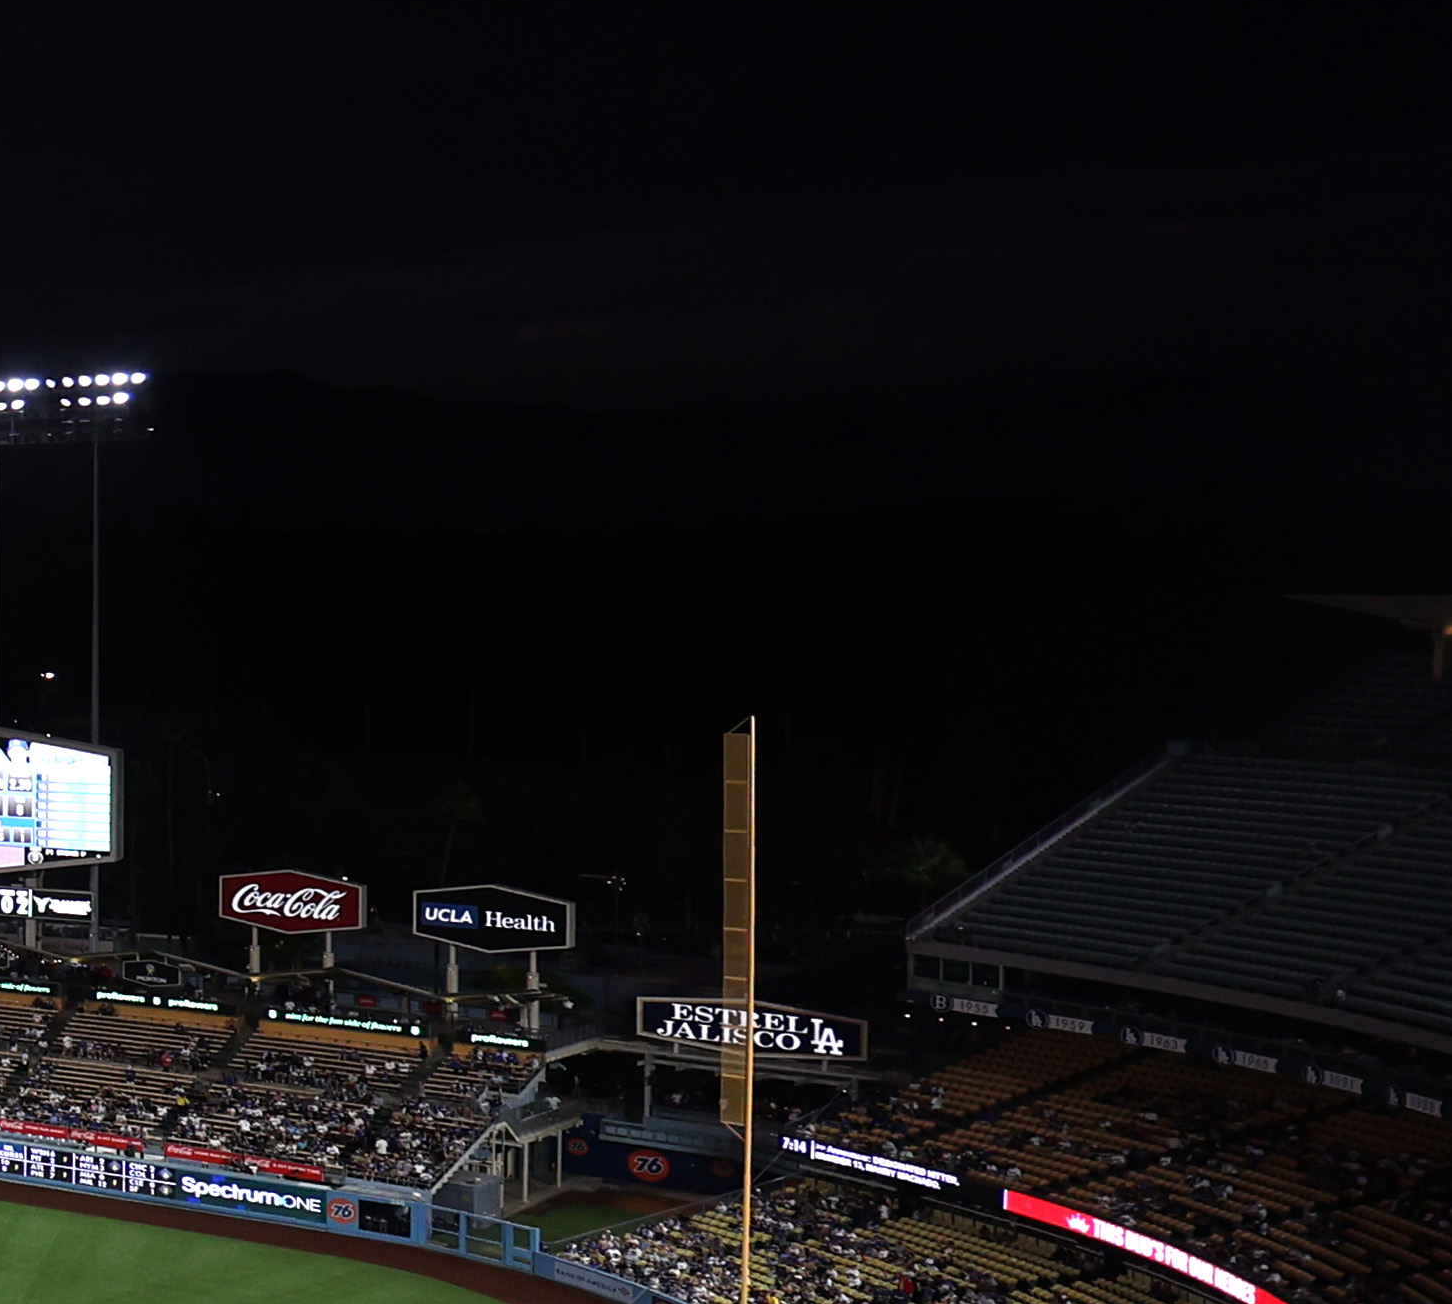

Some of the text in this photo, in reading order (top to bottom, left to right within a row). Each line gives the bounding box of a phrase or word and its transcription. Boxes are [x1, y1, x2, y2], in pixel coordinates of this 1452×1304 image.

[232, 884, 347, 921] Coca-Cola
[425, 907, 556, 933] UCLA Health
[958, 1000, 991, 1014] 1955
[671, 1003, 808, 1033] ESTREL
[1053, 1017, 1086, 1031] 1959
[656, 1019, 800, 1051] JALISCO
[1149, 1035, 1180, 1049] 1963
[1240, 1054, 1270, 1070] 1965
[781, 1137, 807, 1153] 7:14
[633, 1157, 664, 1175] 76
[331, 1203, 353, 1218] 76
[1092, 1219, 1256, 1304] THIS BUD'S FOR OUR HEROES
